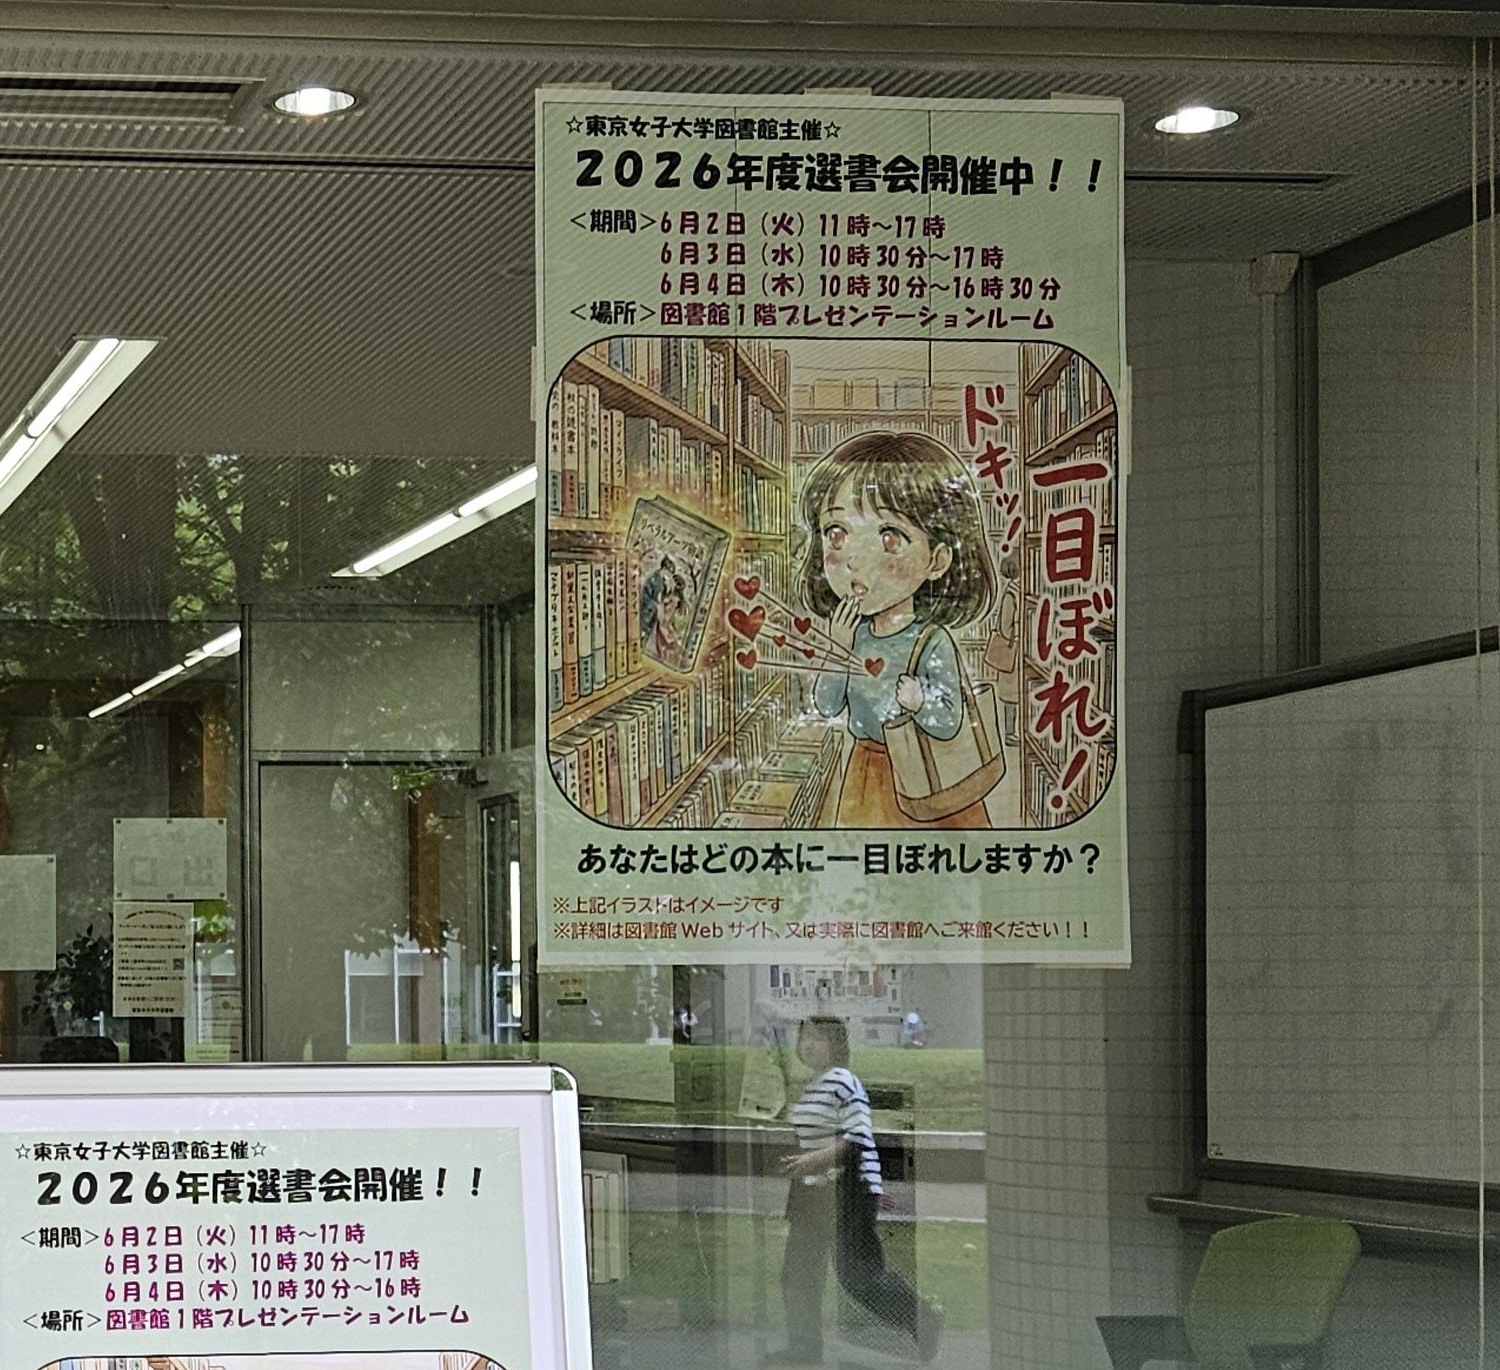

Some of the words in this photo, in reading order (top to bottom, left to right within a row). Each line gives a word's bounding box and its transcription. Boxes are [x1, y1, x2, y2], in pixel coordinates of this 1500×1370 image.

[575, 148, 1102, 196] 2026年度選書会開催中！！
[1033, 462, 1113, 808] 一目ぼれ！
[577, 842, 1100, 876] あなたはどの本に一目ぼれしますか？
[553, 895, 785, 915] ※上記イラストはイメージです
[37, 1166, 482, 1206] 2026年度選書会開催！！
